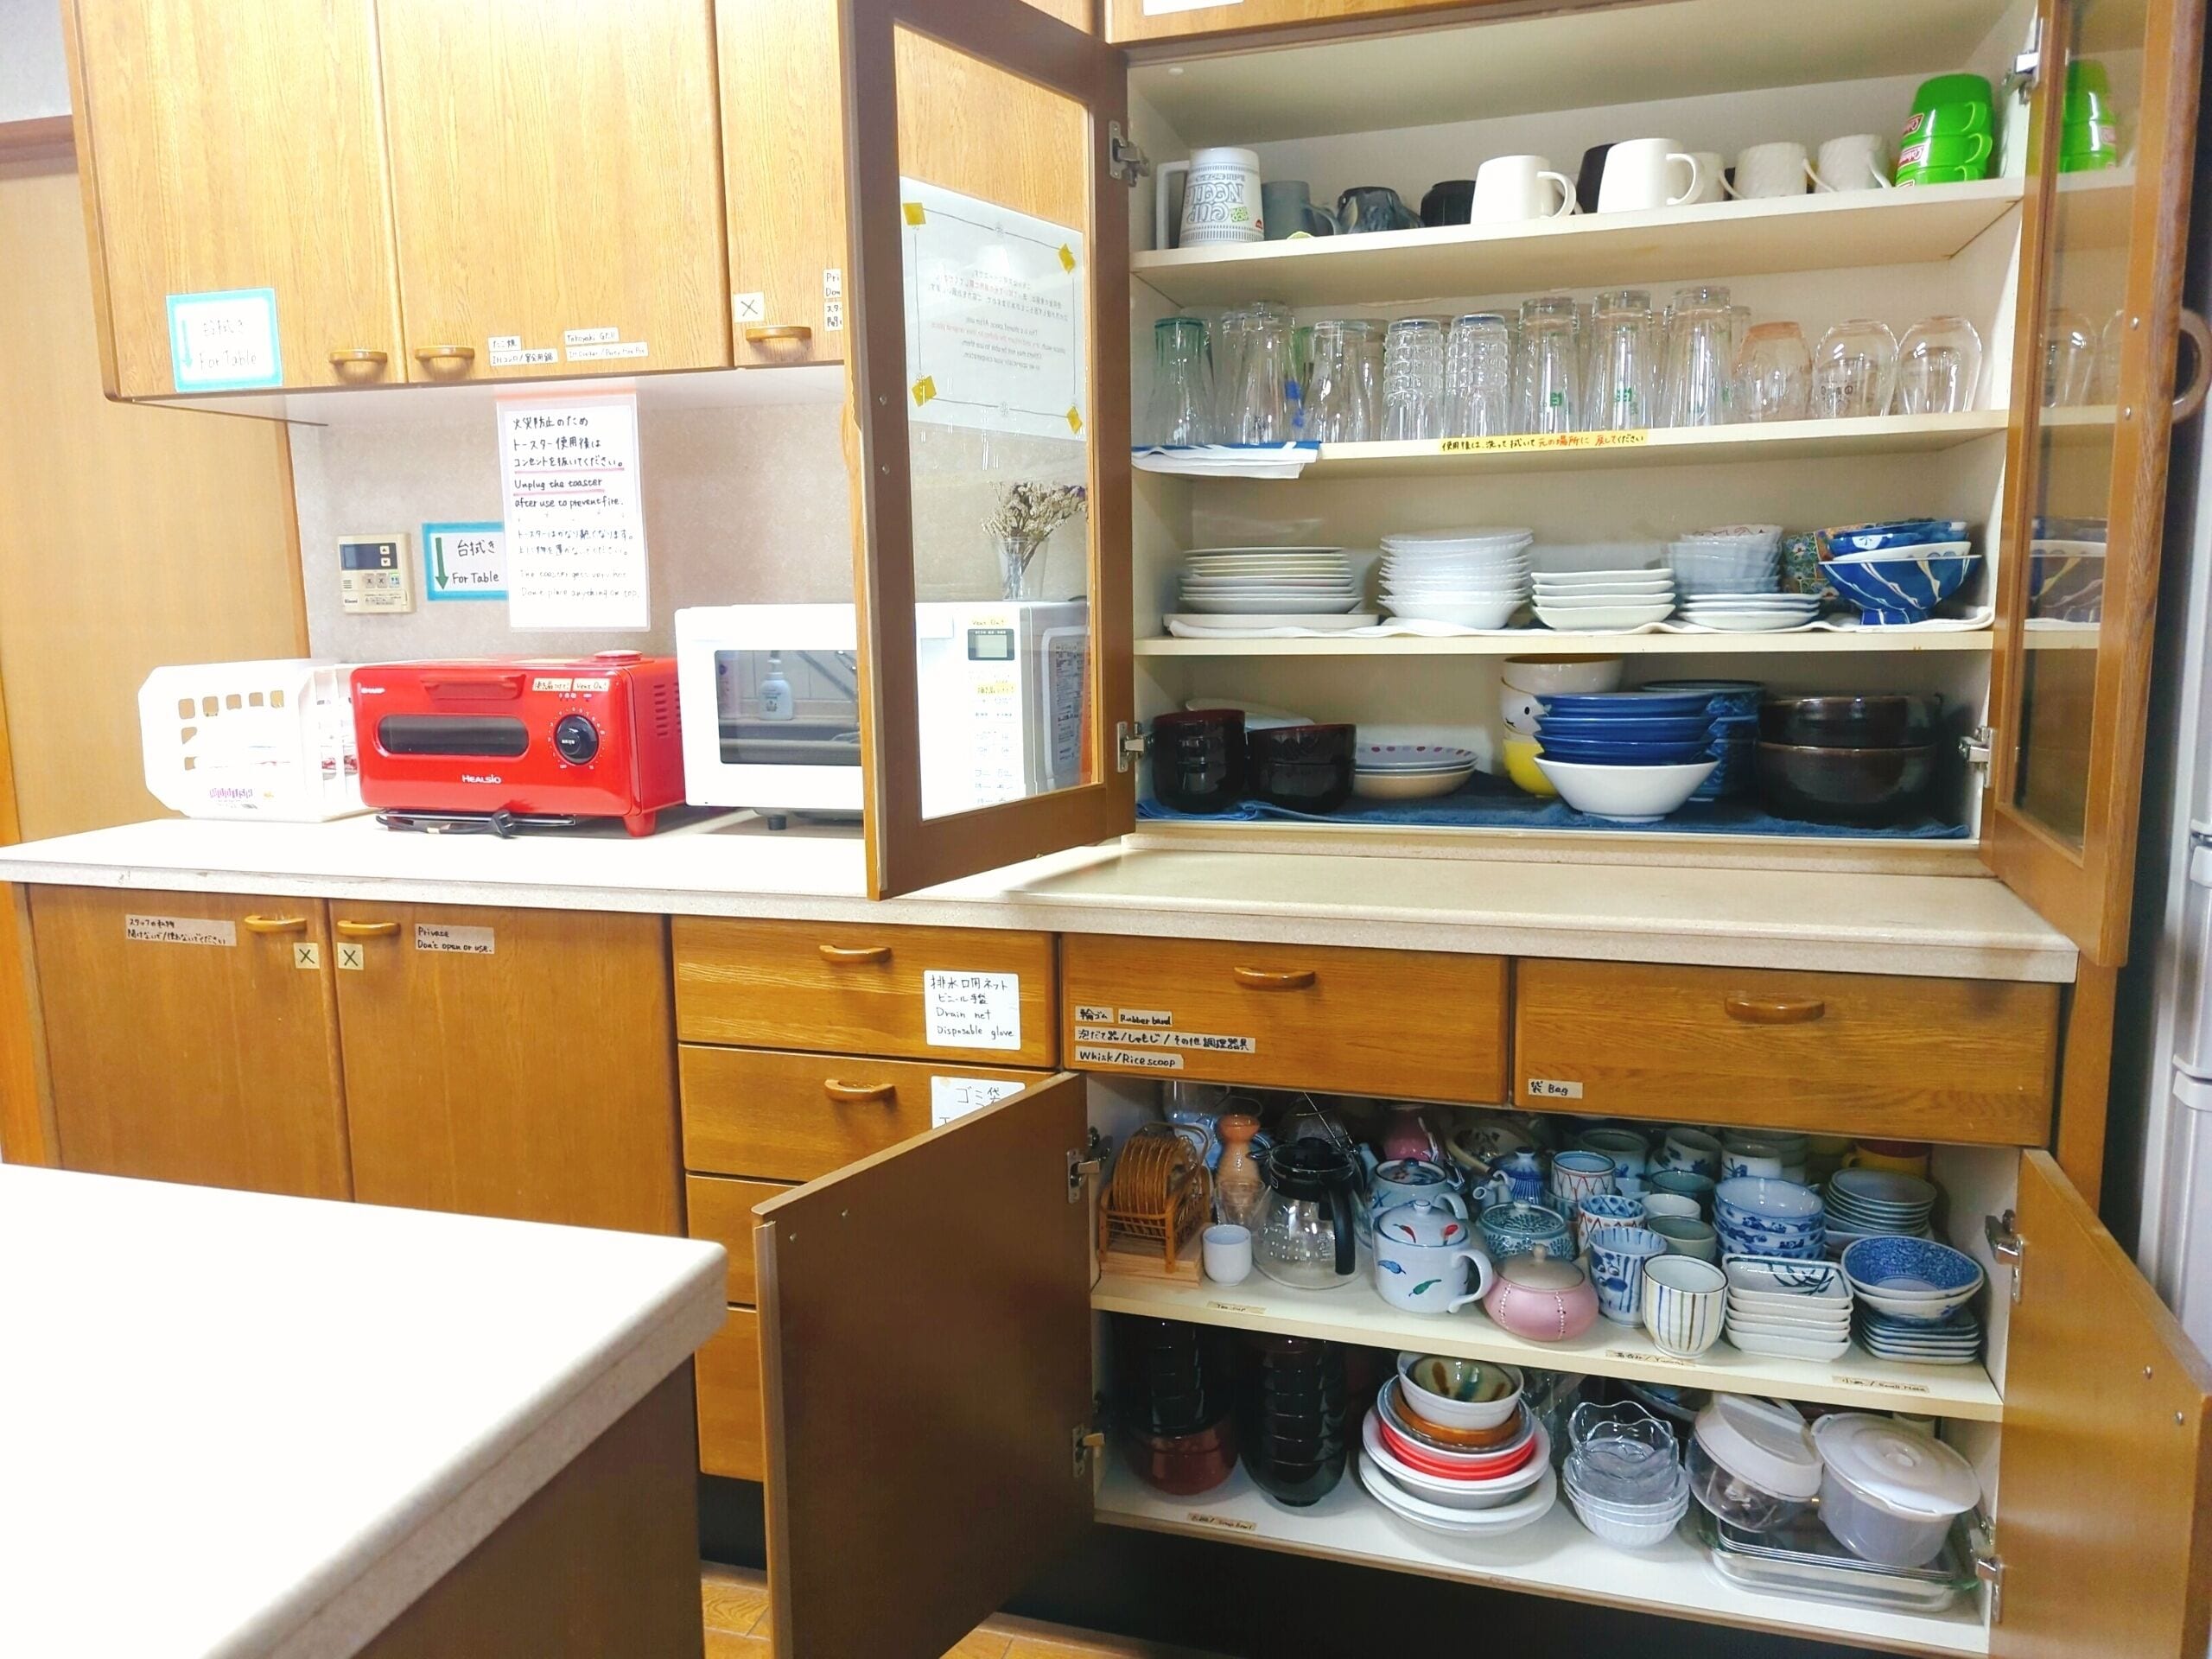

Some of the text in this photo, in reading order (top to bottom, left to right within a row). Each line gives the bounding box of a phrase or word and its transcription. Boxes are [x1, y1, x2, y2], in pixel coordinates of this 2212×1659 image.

[512, 416, 589, 430] 火災防止のため
[513, 435, 602, 449] トースター使用後は
[514, 478, 603, 491] Unplug the toaster
[514, 498, 537, 508] after
[539, 499, 556, 508] use
[558, 497, 568, 507] to
[457, 539, 495, 557] 台拭き
[452, 570, 500, 585] For Table
[418, 925, 449, 938] Private
[417, 939, 439, 950] Don't
[442, 942, 461, 951] open
[930, 975, 1009, 991] 排水口用ネット
[936, 1007, 992, 1020] Drain net
[1079, 1007, 1109, 1021] 輪ゴム
[1120, 1013, 1172, 1027] Rubber band
[937, 1024, 1015, 1040] Disposable glove
[1147, 1057, 1176, 1068] scoop
[1548, 1083, 1569, 1096] Bag
